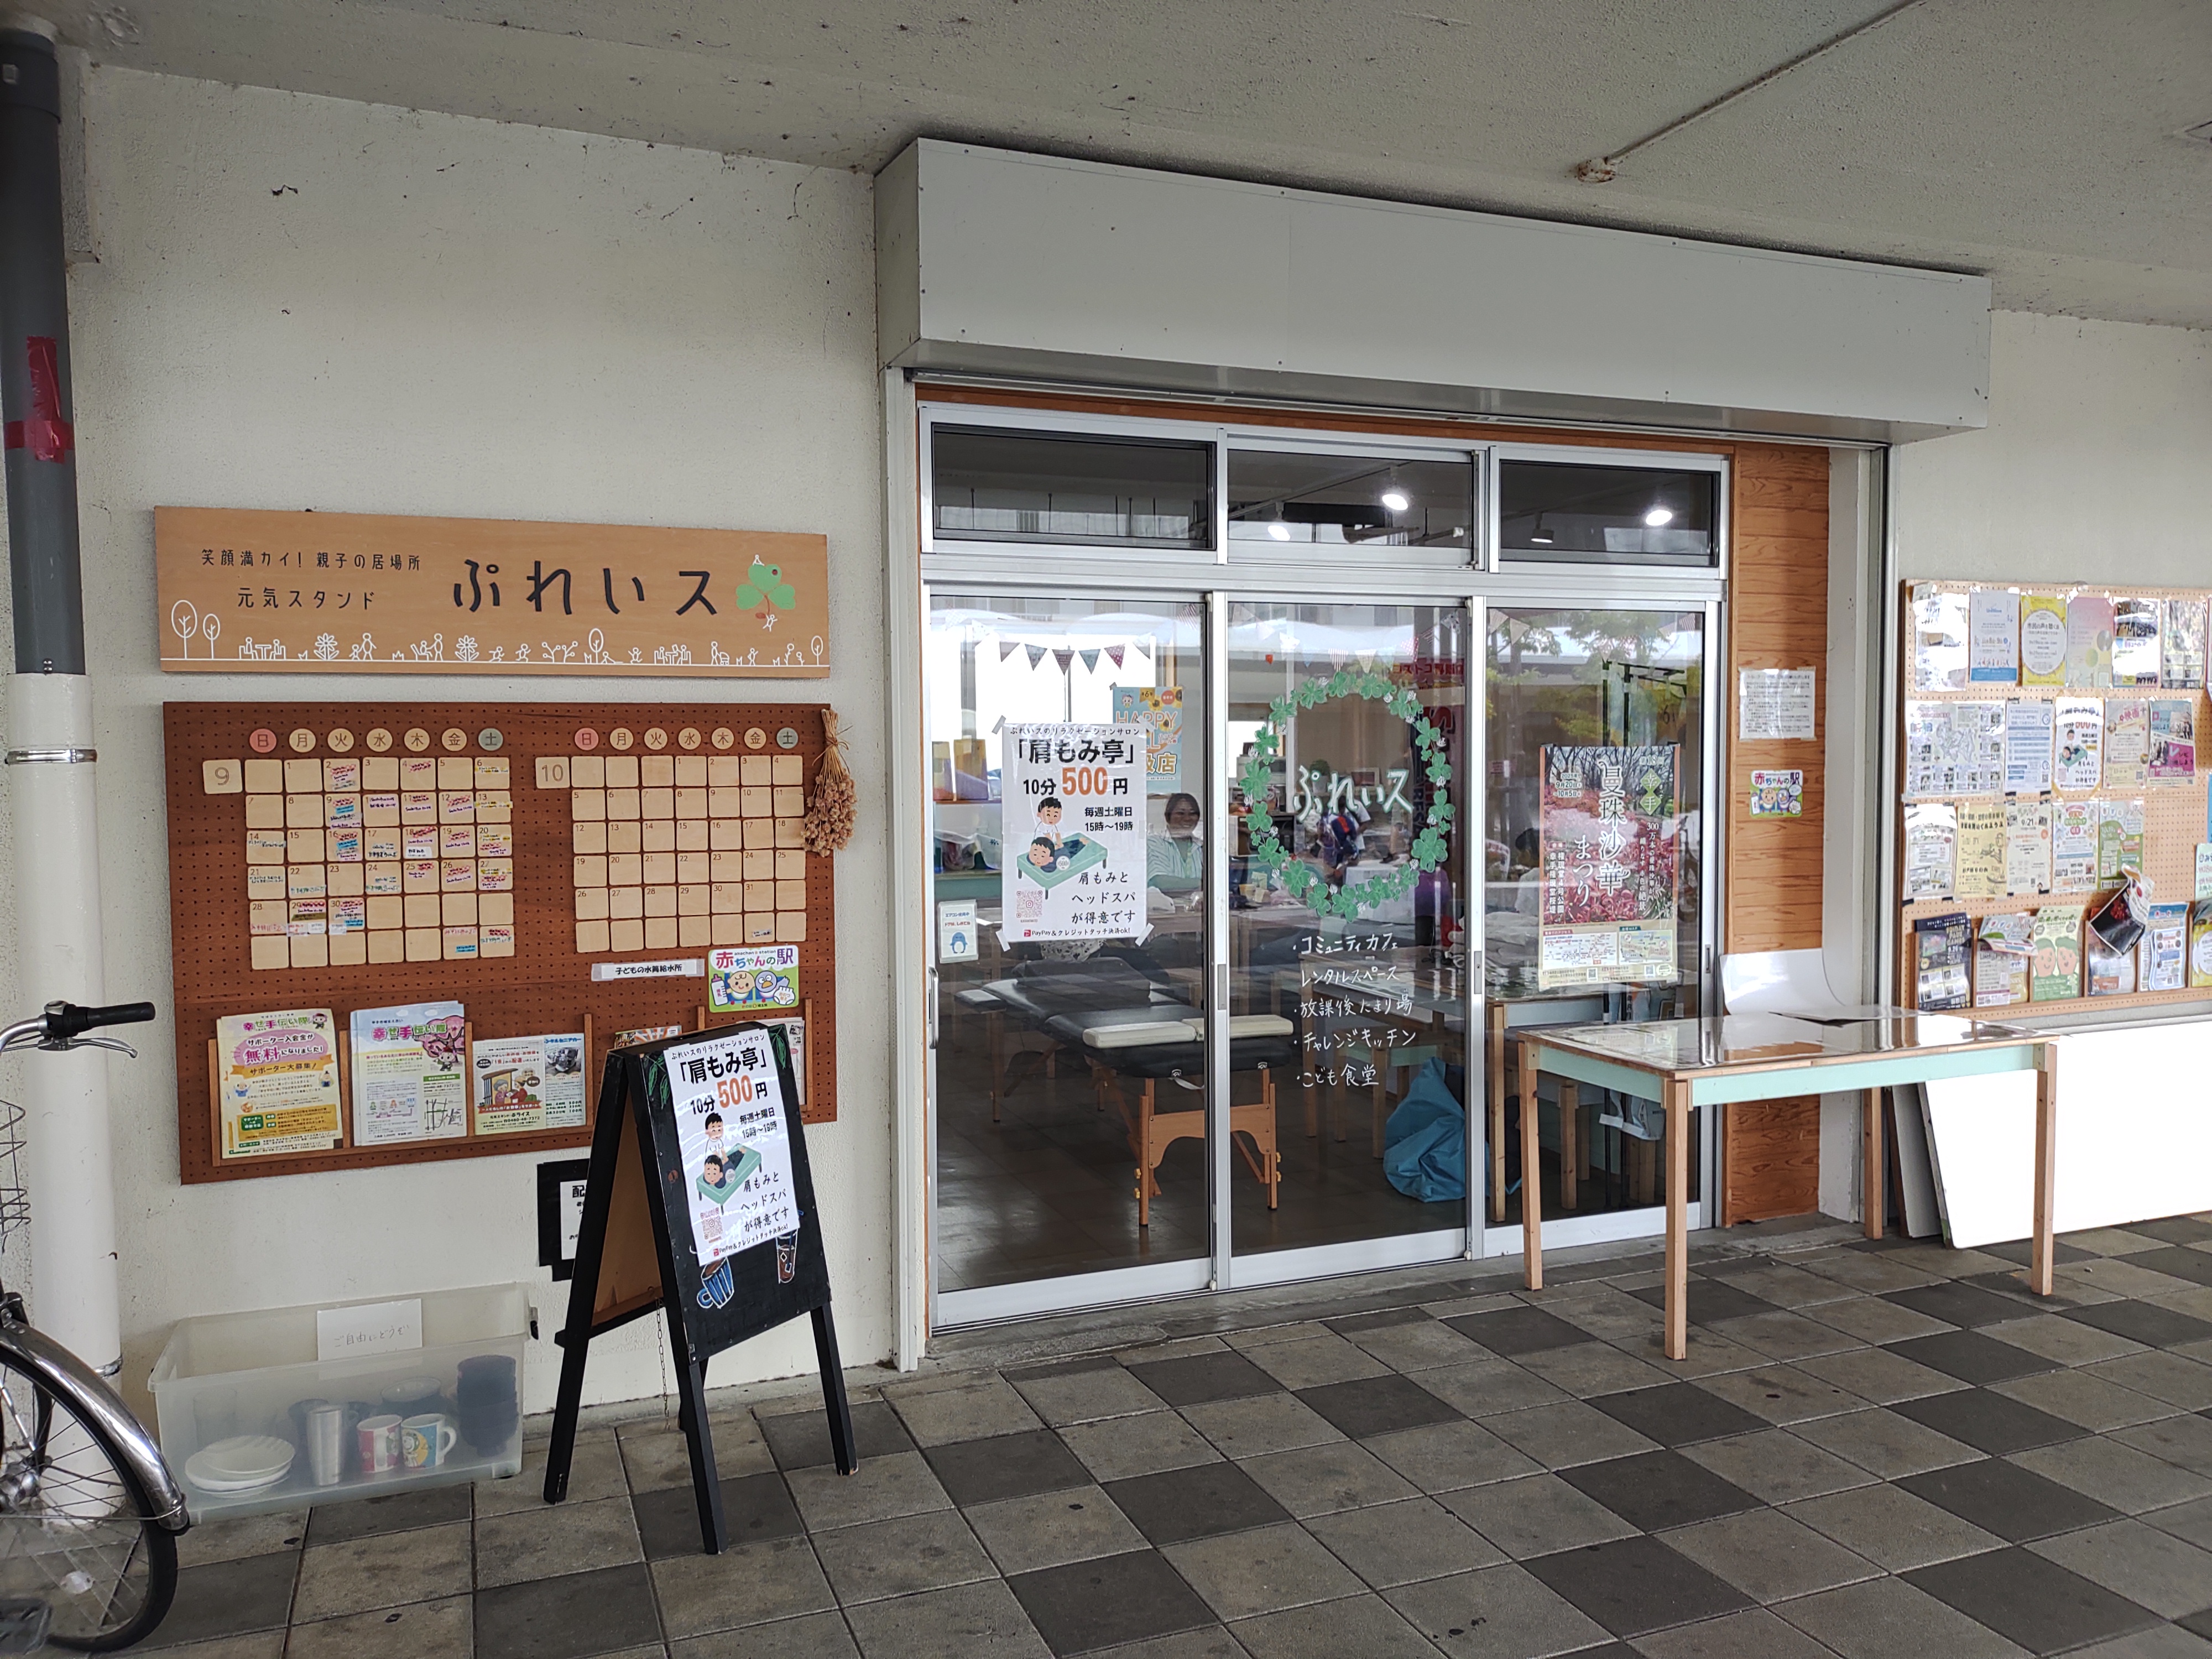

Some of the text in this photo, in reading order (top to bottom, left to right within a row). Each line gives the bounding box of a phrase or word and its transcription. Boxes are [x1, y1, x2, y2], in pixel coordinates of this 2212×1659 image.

[316, 551, 421, 572] 親子の居場所
[453, 559, 717, 615] ぷれいス
[238, 587, 375, 609] 元気スタンド
[257, 732, 497, 747] 日 月 火 水 木 金 土
[582, 732, 793, 745] 日 月 火 水 木 金 土
[1019, 738, 1134, 764] 「肩もみ亭」
[215, 767, 229, 785] 9
[542, 764, 564, 781] 10
[1023, 766, 1128, 796] 10分 500 円
[1293, 765, 1415, 823] ぷれいス
[1643, 773, 1658, 812] 幸手
[1084, 807, 1133, 817] 毎週土曜日
[1597, 760, 1629, 896] 曼珠沙華
[1078, 872, 1129, 885] 肩もみと
[1573, 834, 1593, 907] まつり
[1072, 892, 1136, 905] ヘッドスパ
[1071, 910, 1136, 925] が得意です
[716, 948, 794, 968] 赤ちゃんの駅
[615, 964, 682, 975] 子どもの水筒給水所
[248, 1034, 314, 1046] サポーター入会金が
[680, 1047, 767, 1084] 「肩もみ亭」
[691, 1075, 768, 1115] 10分 500 円
[739, 1107, 775, 1125] 毎週土曜日
[743, 1172, 779, 1192] 肩もみと
[740, 1188, 786, 1211] ヘッドスパ
[744, 1207, 789, 1232] が得意です
[333, 1324, 410, 1348] ご自由にどうぞ
